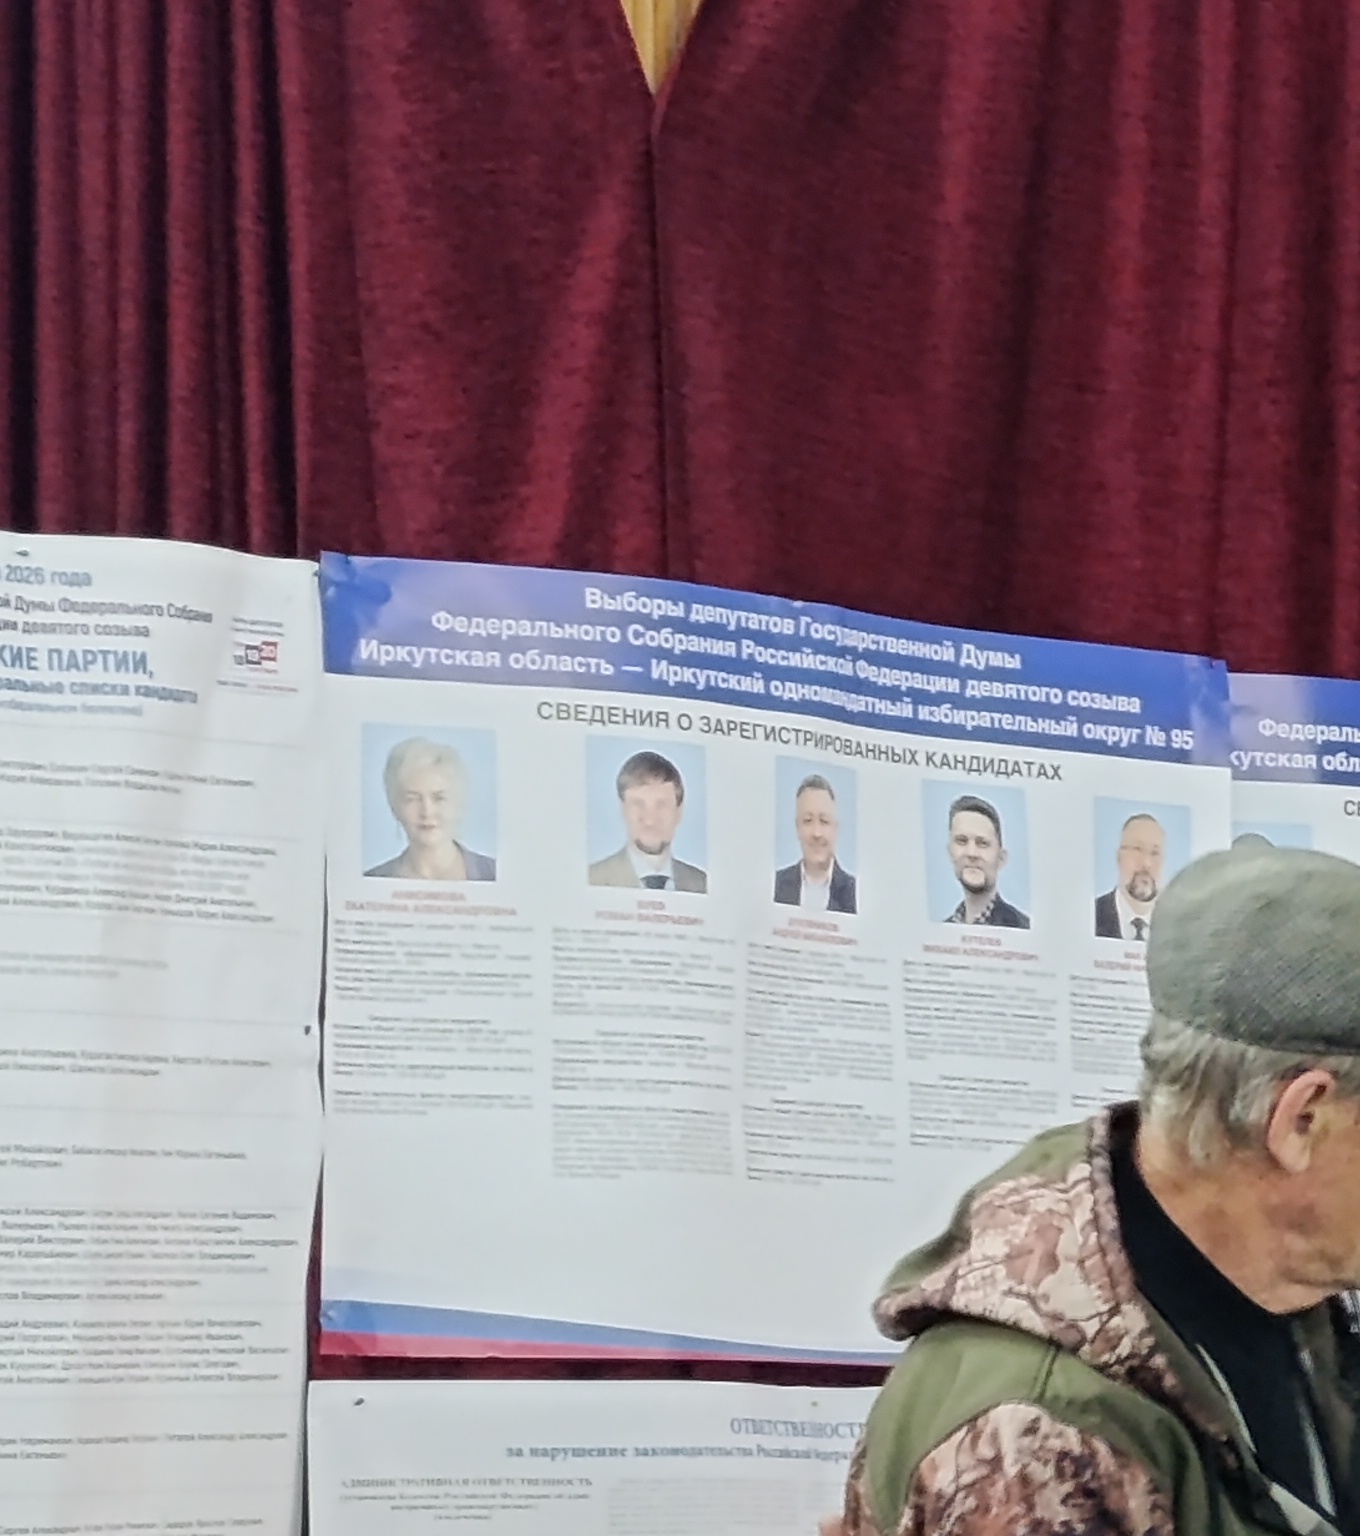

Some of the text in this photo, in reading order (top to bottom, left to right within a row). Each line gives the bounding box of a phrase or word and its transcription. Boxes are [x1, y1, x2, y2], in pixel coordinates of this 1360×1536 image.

[5, 564, 92, 587] 2026 года
[48, 647, 153, 679] ПАРТИИ,
[431, 611, 621, 643] Федерального
[627, 624, 737, 658] Собрания
[740, 639, 853, 676] Российской
[965, 679, 1063, 704] девятого
[1067, 689, 1141, 714] созыва
[585, 587, 685, 618] Выборы
[689, 602, 795, 635] депутатов
[959, 644, 1021, 670] Думы
[359, 639, 501, 669] Иркутская
[508, 650, 614, 676] область
[650, 659, 765, 695] Иркутский
[918, 703, 1078, 738] избирательный
[1082, 722, 1141, 747] округ
[1144, 724, 1167, 747] №
[1170, 728, 1194, 750] 95
[537, 701, 1063, 781] СВЕДЕНИЯ О ЗАРЕГИСТРИРОВАННЫХ КАНДИДАТАХ
[505, 1448, 523, 1458] за
[529, 1447, 627, 1462] нарушение
